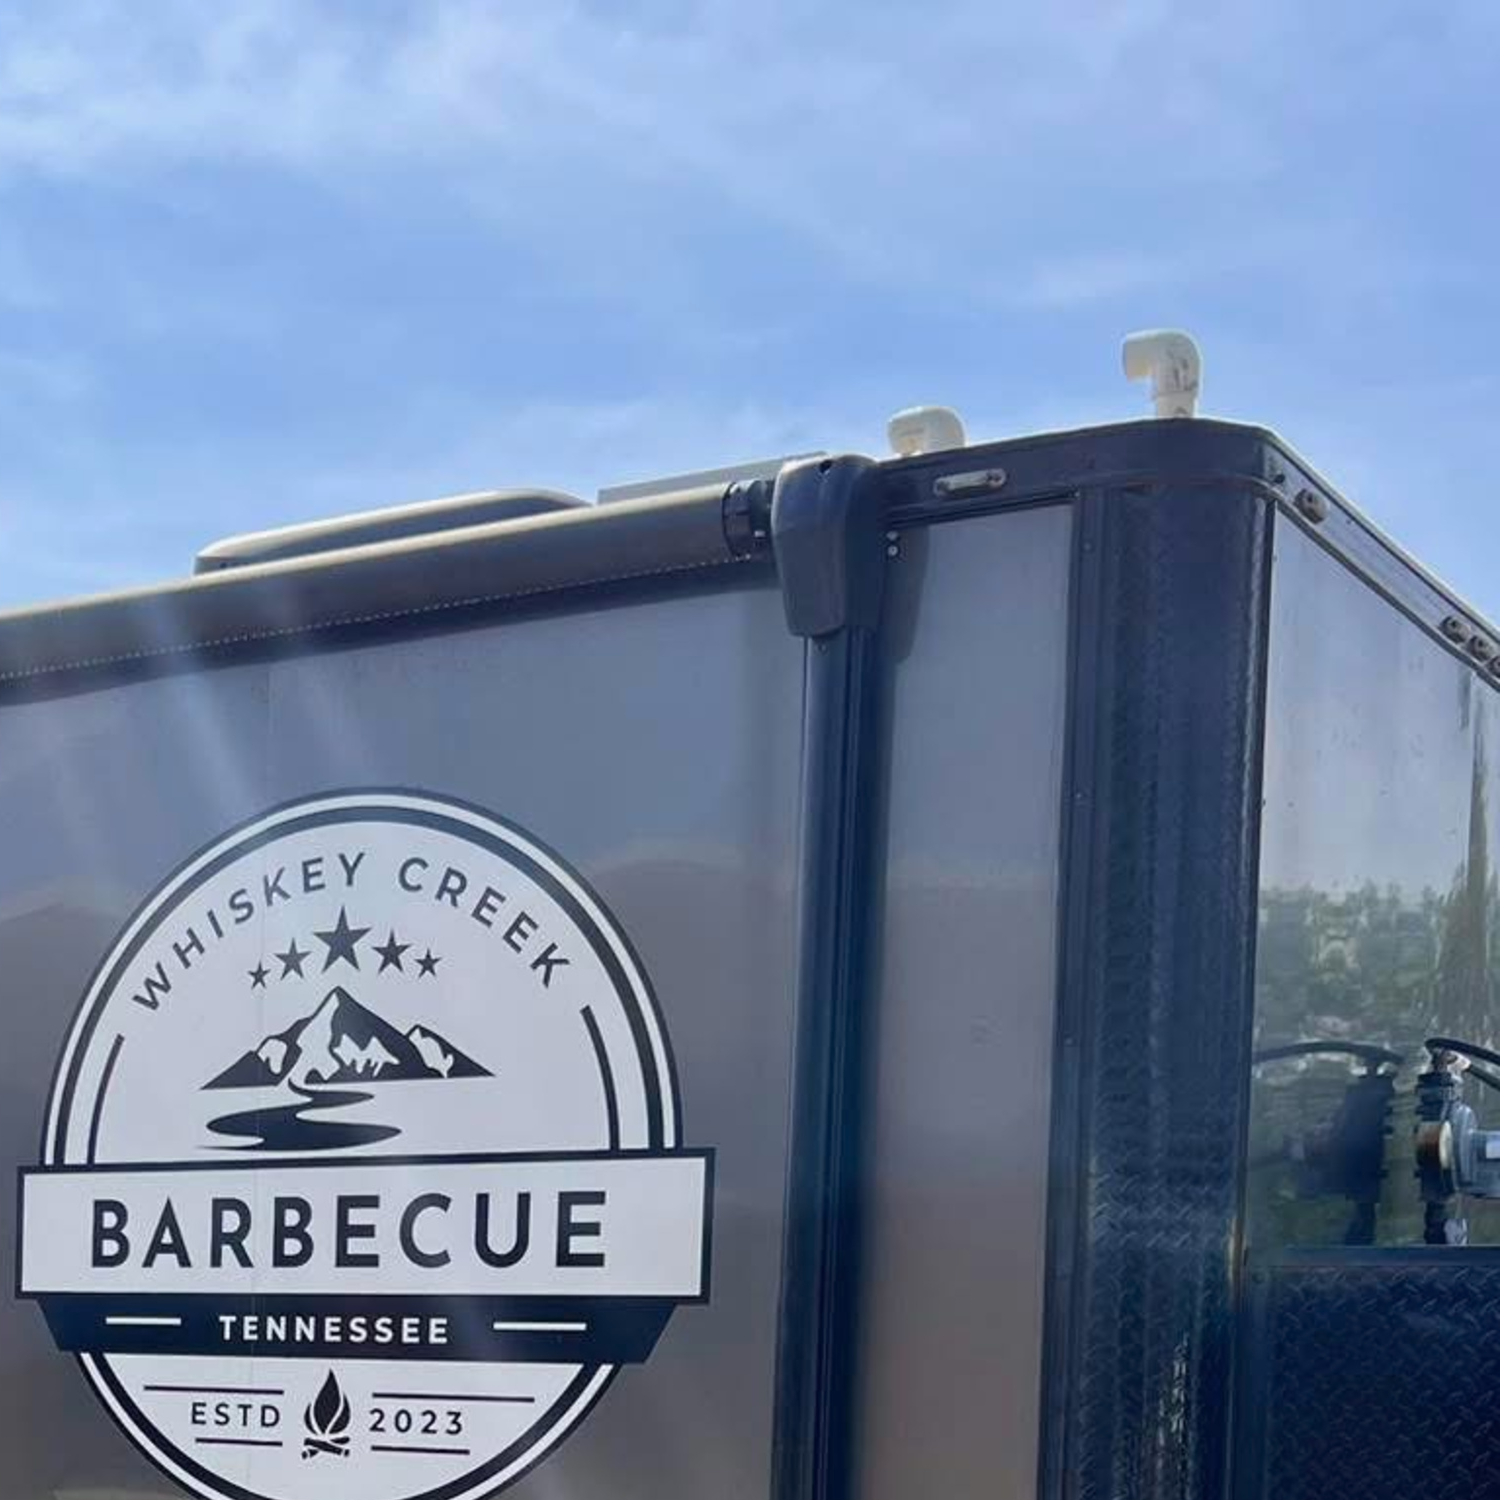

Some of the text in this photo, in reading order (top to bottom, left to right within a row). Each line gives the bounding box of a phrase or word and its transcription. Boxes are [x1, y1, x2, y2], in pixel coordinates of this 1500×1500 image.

[131, 850, 571, 1014] WHISKEY CREEK
[90, 1190, 607, 1269] BARBECUE
[218, 1314, 449, 1346] TENNESSEE
[190, 1401, 465, 1436] ESTD 2023
